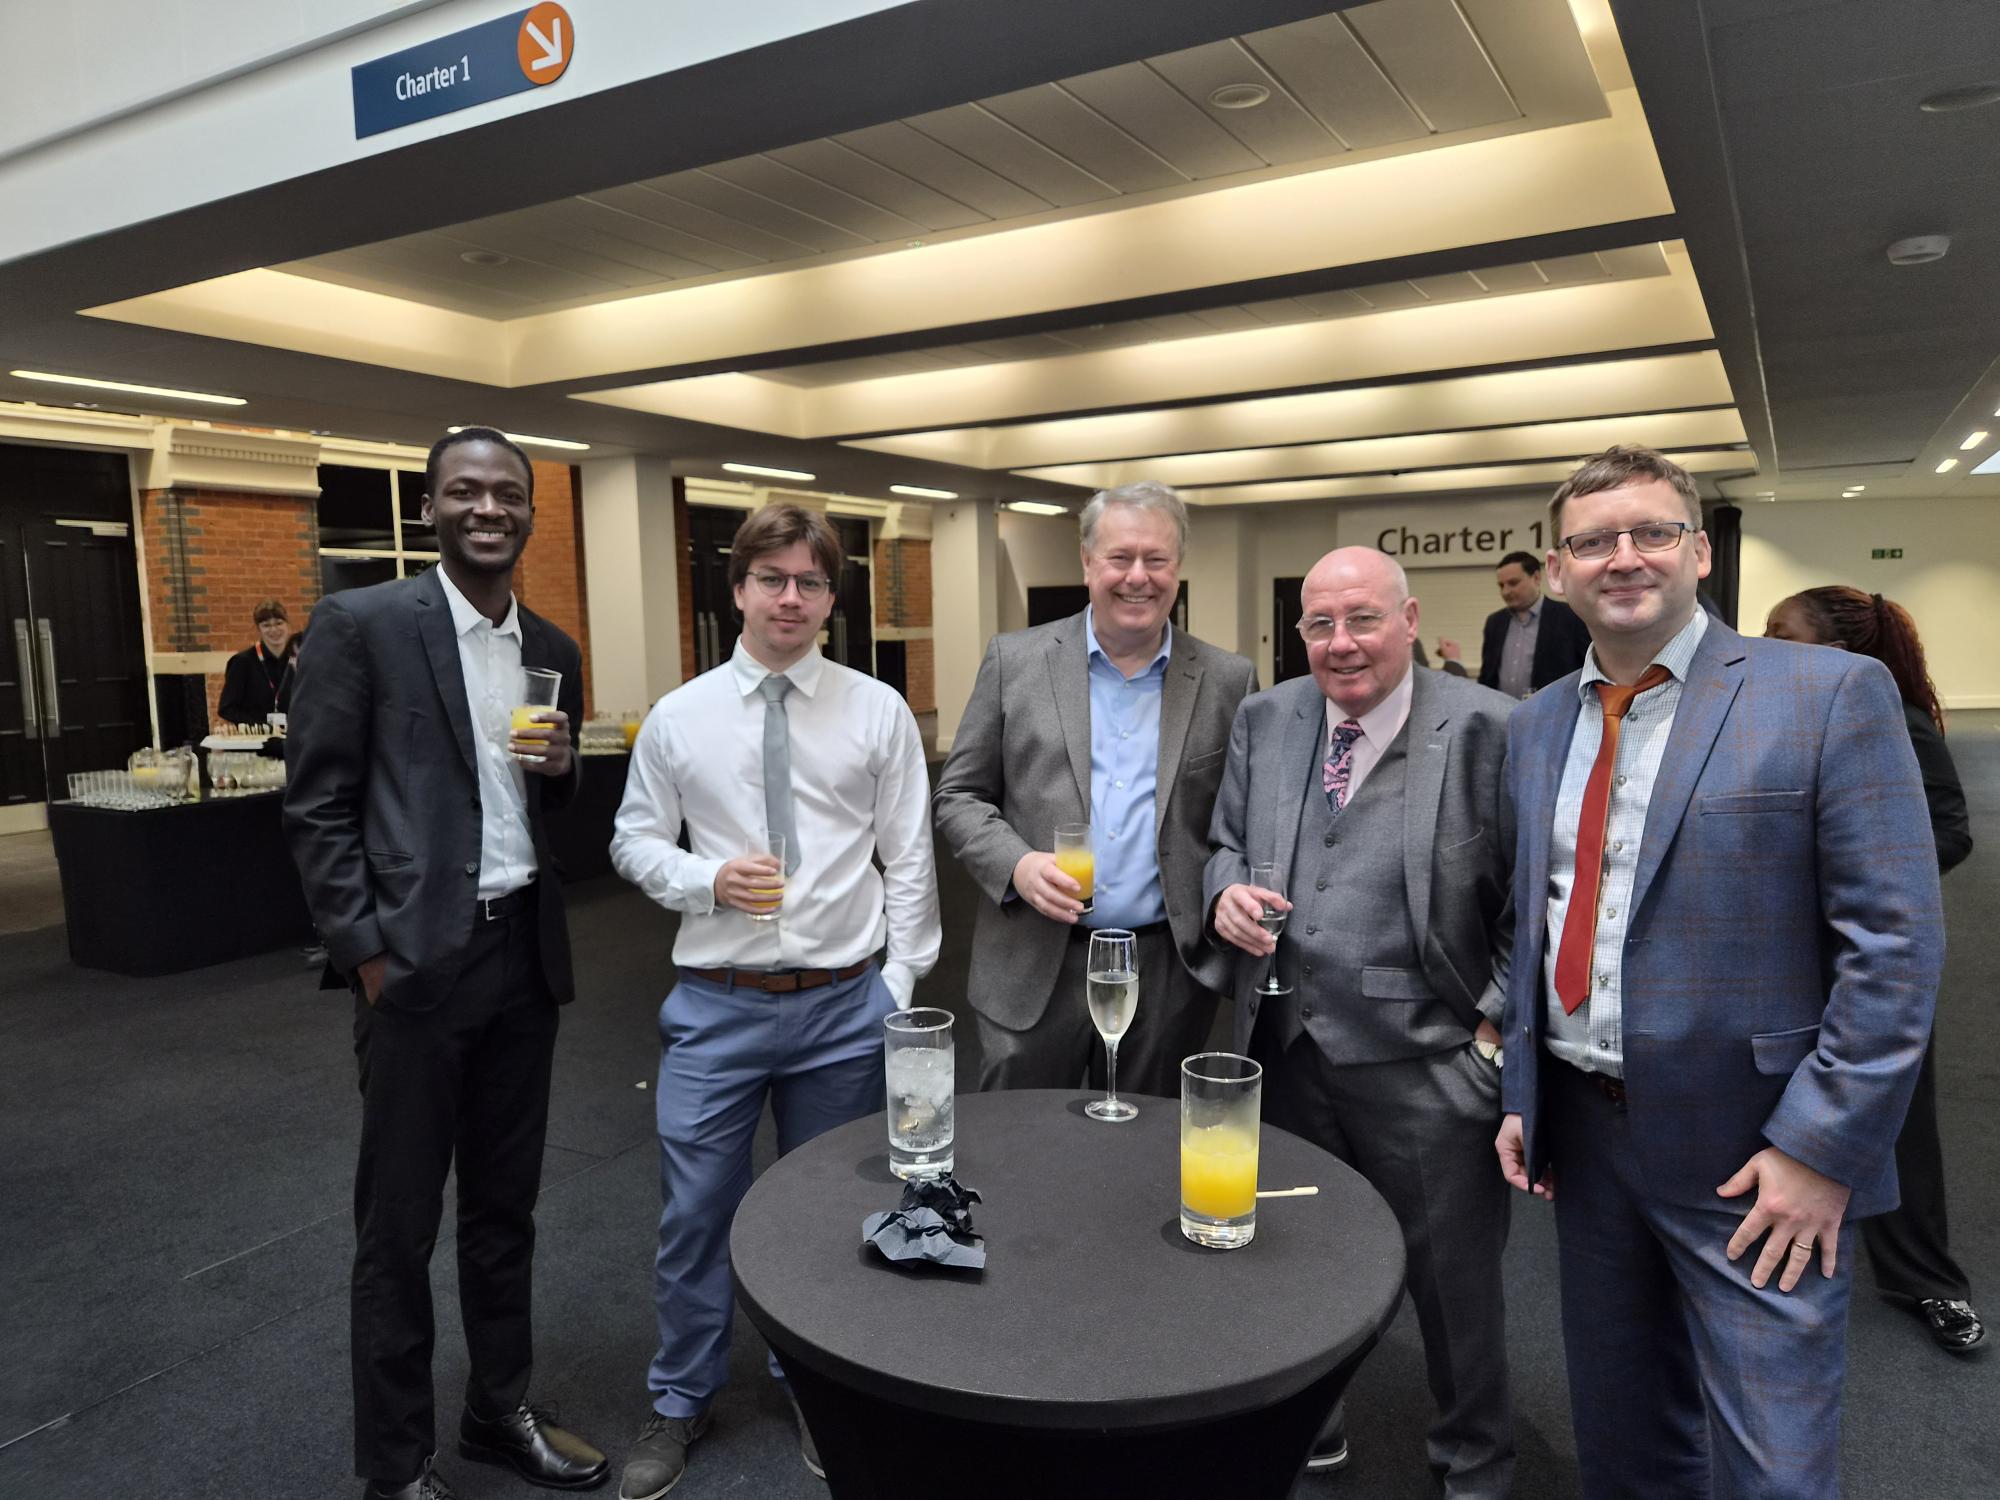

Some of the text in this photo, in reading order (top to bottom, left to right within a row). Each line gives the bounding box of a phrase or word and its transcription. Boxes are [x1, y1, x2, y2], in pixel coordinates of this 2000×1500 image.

[395, 55, 471, 101] Charter 1
[1377, 521, 1543, 556] Charter 1
